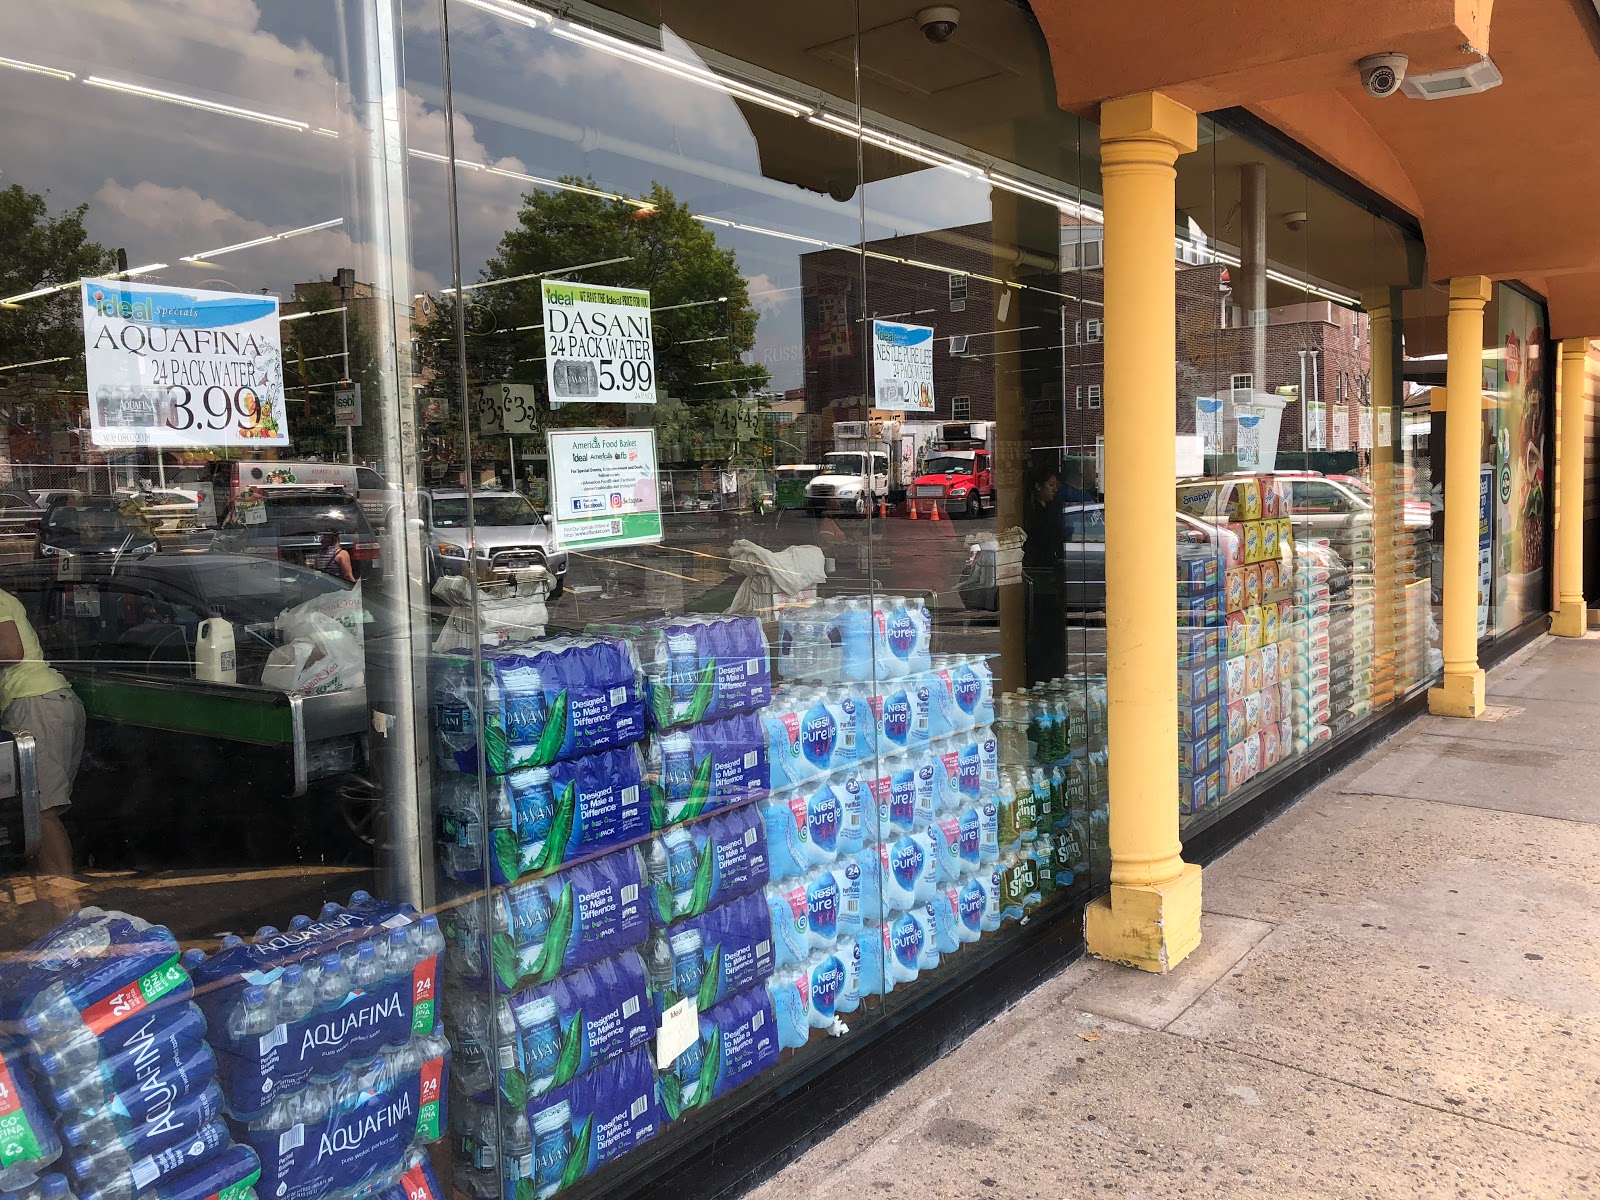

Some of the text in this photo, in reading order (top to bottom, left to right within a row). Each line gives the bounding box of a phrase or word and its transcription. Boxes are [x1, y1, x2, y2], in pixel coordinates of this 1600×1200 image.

[546, 288, 574, 306] ideal
[94, 290, 198, 321] ideal Specials
[548, 309, 650, 339] DASANI
[93, 324, 262, 357] AQUAFINA
[877, 327, 894, 341] ideal
[550, 336, 651, 361] 24 PACK WATER
[876, 344, 932, 365] NESTLE PURE LIFE
[152, 359, 259, 388] 24 PACK WATER
[600, 359, 652, 392] 5.99
[119, 398, 157, 412] AQUAFINA
[165, 385, 262, 430] 3.99
[603, 440, 617, 449] Food
[620, 439, 637, 448] Basket
[573, 453, 588, 462] ideal
[719, 664, 744, 675] Designed
[719, 681, 747, 691] Difference
[919, 689, 929, 698] 24
[572, 695, 606, 709] Designed
[844, 701, 854, 709] 24
[507, 708, 547, 728] DASANI
[572, 711, 581, 719] to
[583, 707, 600, 716] Make
[574, 713, 611, 727] Difference
[985, 741, 995, 750] 24
[715, 758, 741, 770] Designed
[921, 767, 933, 776] 24
[715, 774, 744, 787] Difference
[848, 781, 858, 789] 24
[580, 786, 612, 802] Designed
[580, 803, 588, 811] to
[590, 798, 607, 808] Make
[581, 805, 617, 820] Difference
[985, 805, 995, 813] 24
[517, 803, 554, 826] DASANI
[717, 838, 742, 853] Designed
[719, 854, 747, 869] Difference
[847, 866, 859, 876] 24
[579, 886, 611, 903] Designed
[580, 904, 588, 912] to
[590, 899, 606, 910] Make
[581, 904, 616, 920] Difference
[514, 907, 552, 929] DASANI
[256, 912, 364, 955] AQUAFINA
[724, 945, 750, 961] Designed
[725, 958, 754, 975] Difference
[150, 970, 166, 992] FINA
[416, 977, 431, 993] 24
[109, 993, 132, 1017] 24
[415, 1009, 430, 1018] FINA
[587, 1008, 619, 1030] Designed
[300, 991, 404, 1061] AQUAFINA
[588, 1019, 621, 1038] to Make a
[723, 1022, 749, 1040] Designed
[589, 1027, 624, 1047] Difference
[322, 1049, 336, 1057] pure
[525, 1037, 562, 1065] DASANI
[725, 1038, 754, 1056] Difference
[123, 1015, 184, 1138] AQUAFINA
[423, 1078, 437, 1094] 24
[420, 1111, 436, 1119] FINA
[421, 1105, 436, 1113] ECO-
[316, 1091, 412, 1165] AQUAFINA
[597, 1110, 628, 1134] Designed
[597, 1134, 605, 1142] to
[606, 1124, 622, 1139] Make
[597, 1128, 632, 1150] Difference
[341, 1155, 354, 1165] pure
[535, 1141, 572, 1172] DASANI
[411, 1186, 428, 1200] 24
